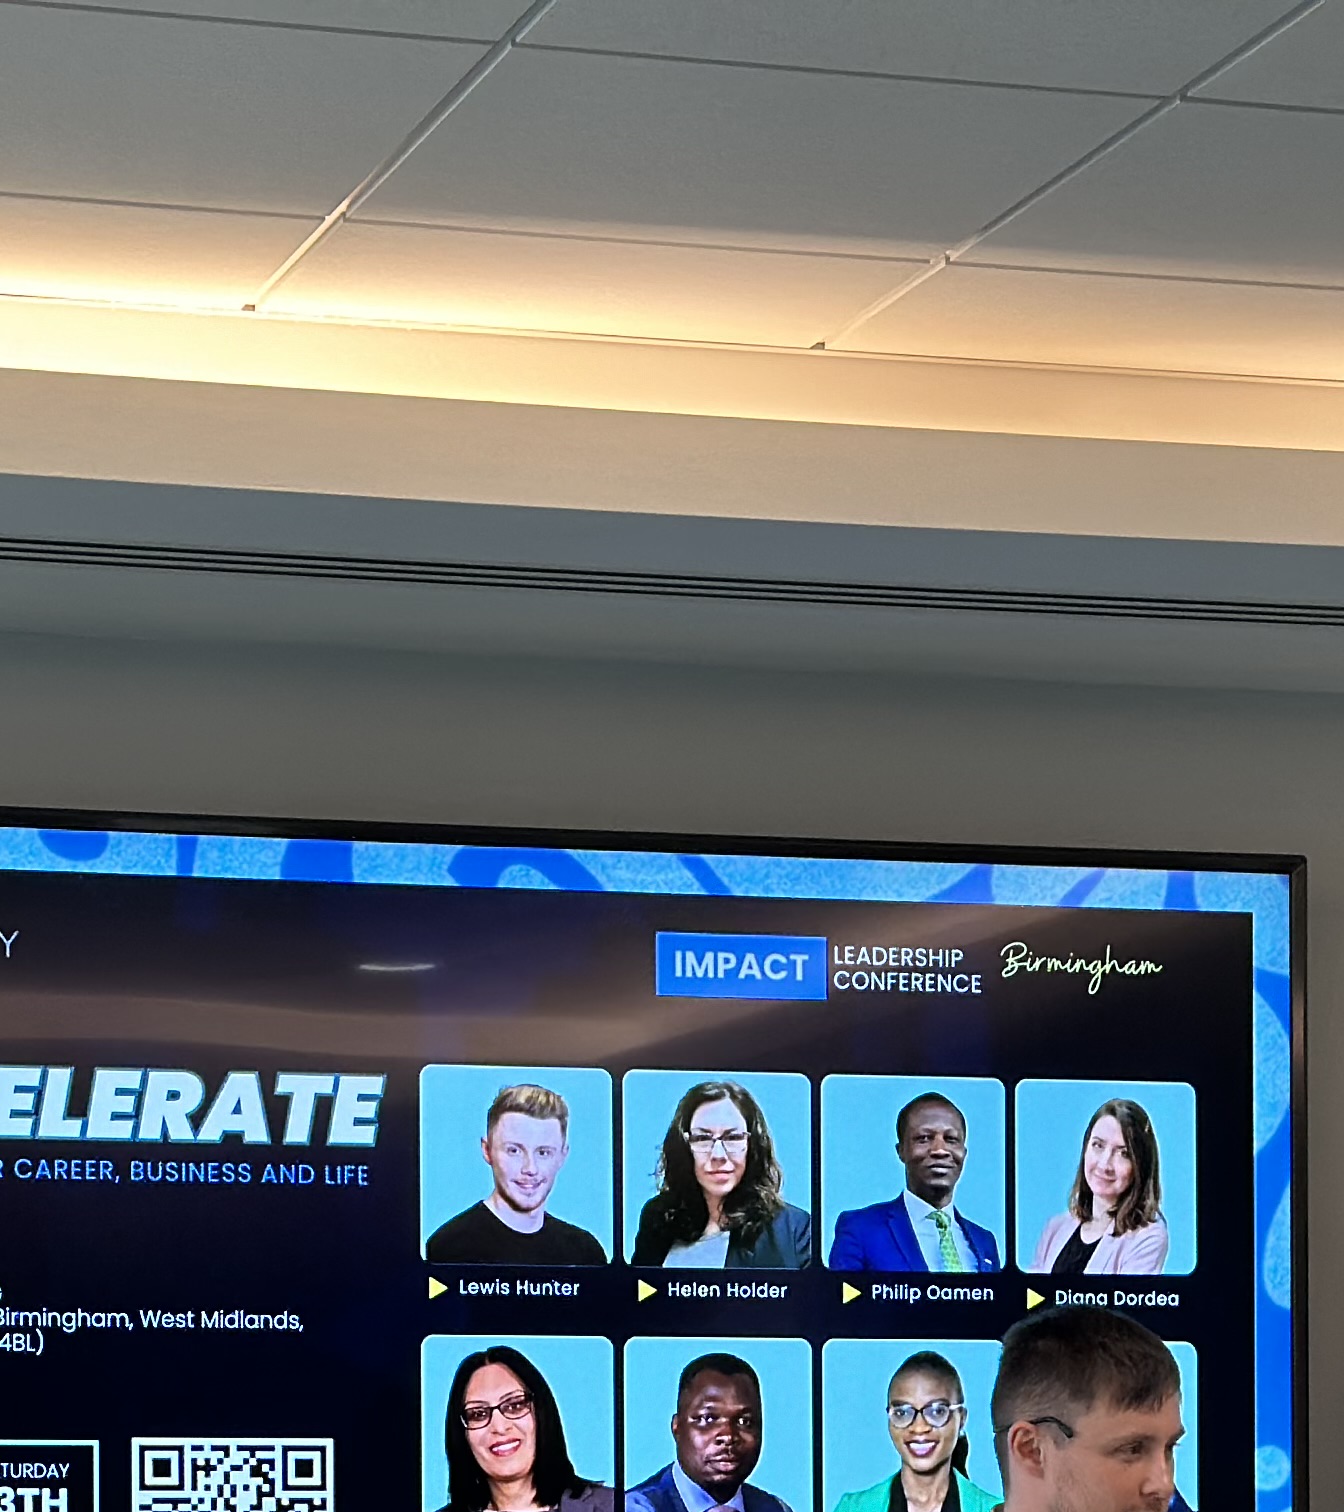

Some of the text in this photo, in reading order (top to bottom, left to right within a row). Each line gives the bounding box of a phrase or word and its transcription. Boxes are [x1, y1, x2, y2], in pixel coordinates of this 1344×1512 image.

[674, 949, 810, 982] IMPACT
[833, 945, 964, 969] LEADERSHIP
[1000, 941, 1163, 996] Birmingham
[833, 970, 982, 994] CONFERENCE
[13, 1158, 121, 1184] CAREER,
[130, 1161, 252, 1184] BUSINESS
[260, 1163, 315, 1185] AND
[324, 1165, 370, 1187] LIFE
[458, 1278, 580, 1298] Lewis Hunter
[667, 1281, 788, 1300] Helen Holder
[871, 1283, 994, 1305] Philip Oamen
[1055, 1288, 1180, 1307] Diana Dordea
[139, 1309, 196, 1329] West
[200, 1309, 304, 1333] Midlands,
